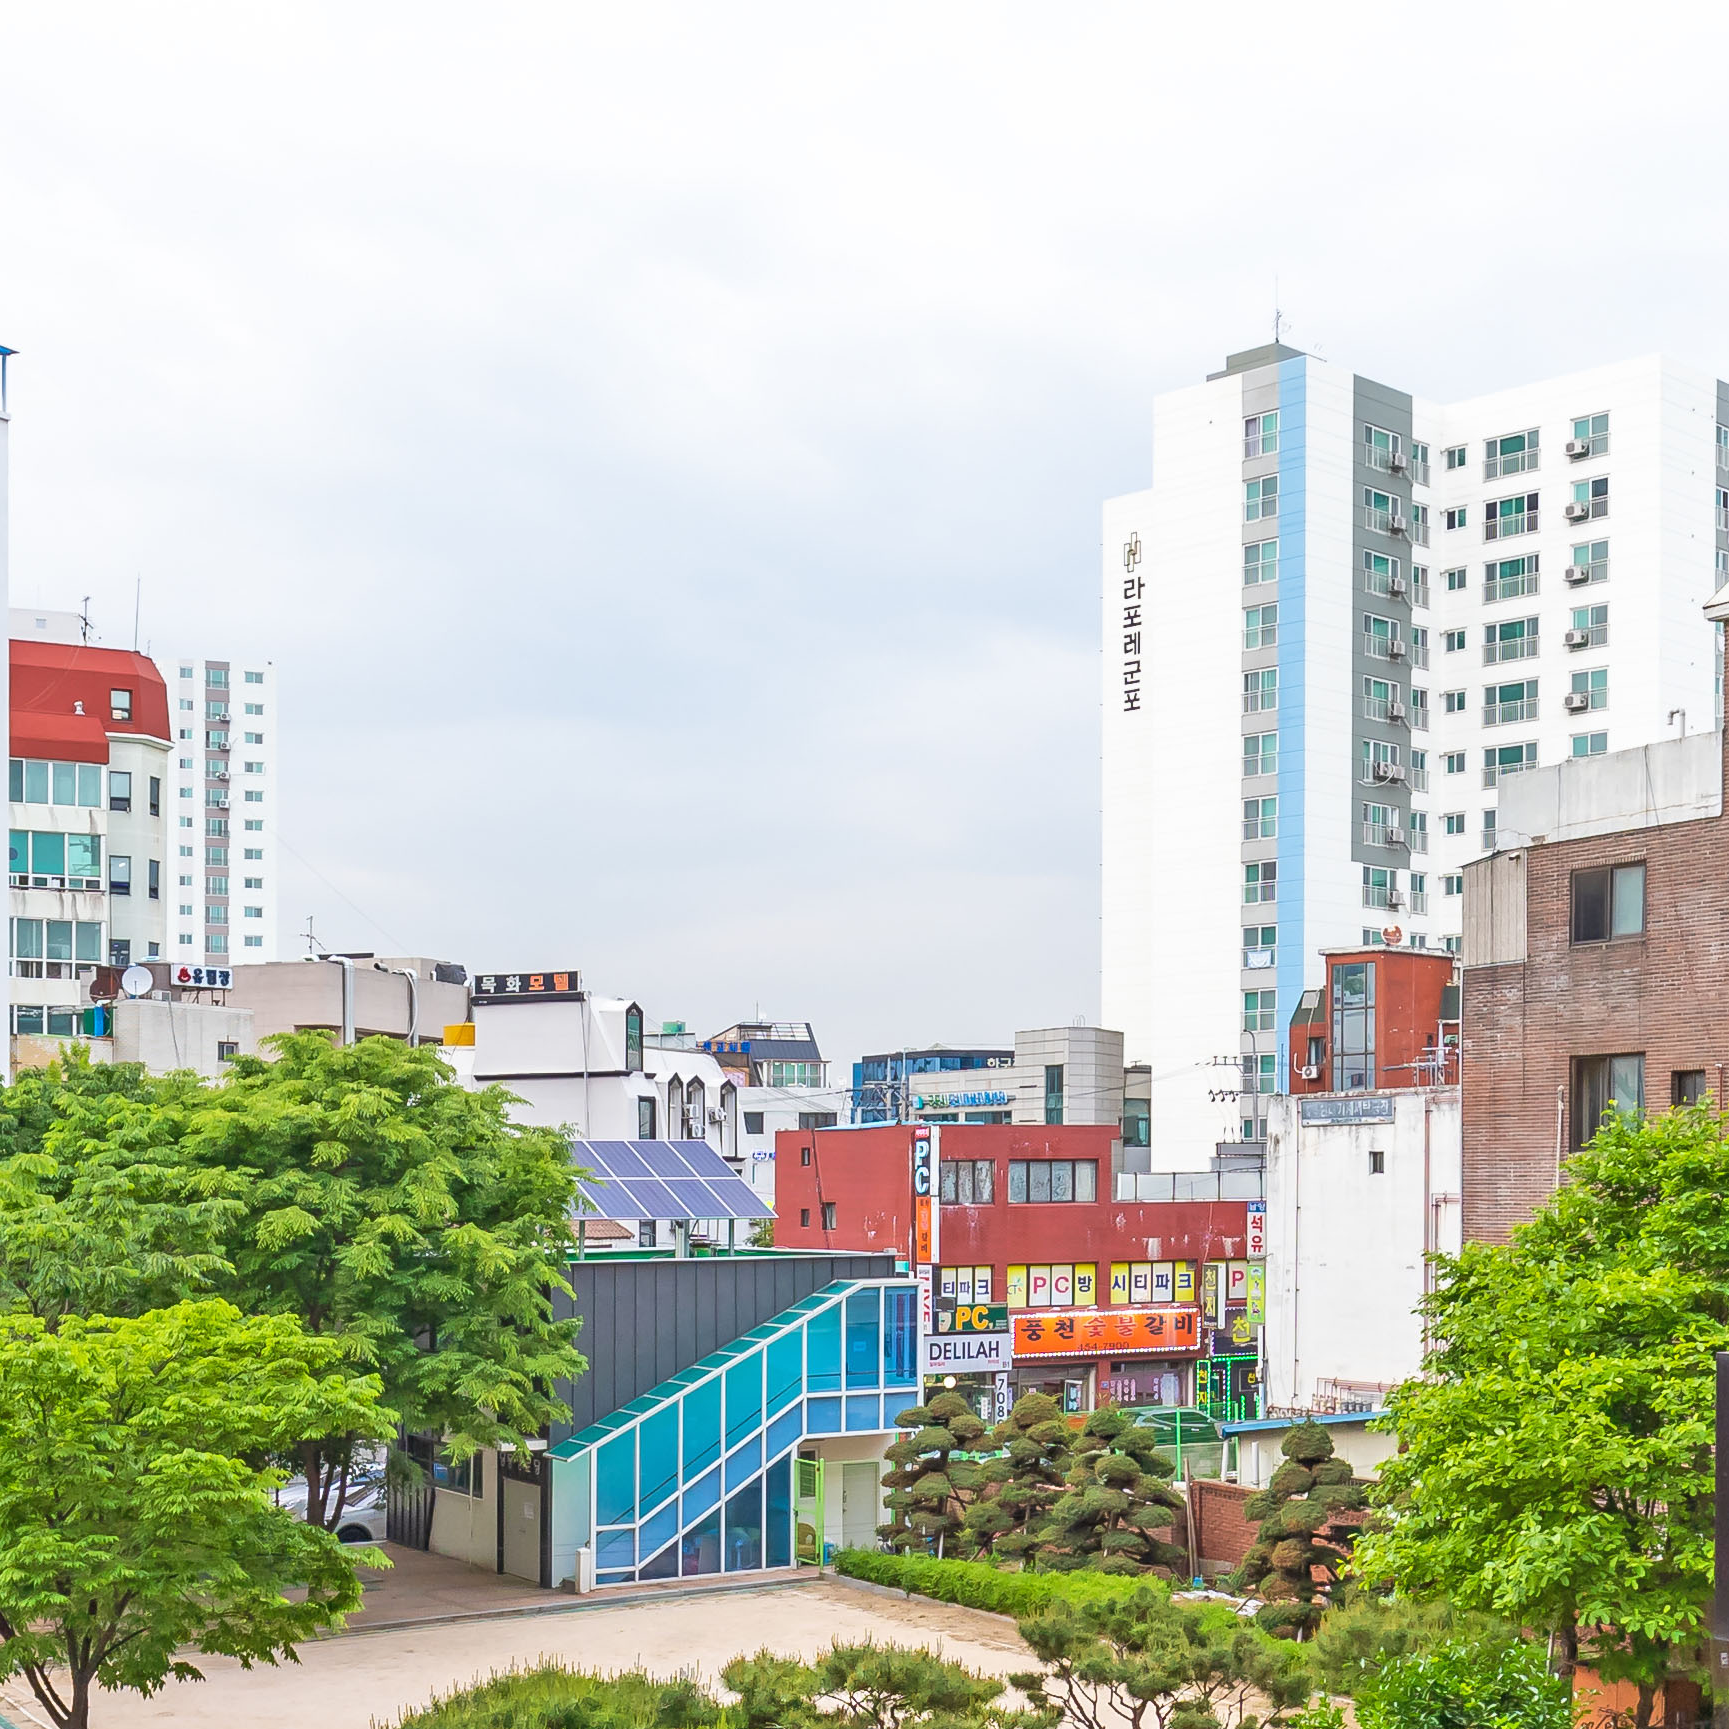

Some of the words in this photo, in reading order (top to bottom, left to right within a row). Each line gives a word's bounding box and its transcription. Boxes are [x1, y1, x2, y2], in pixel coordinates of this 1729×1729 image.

[1122, 575, 1145, 713] 라포레군포
[914, 1140, 930, 1194] PC
[1251, 1215, 1263, 1253] 석유
[1033, 1275, 1092, 1294] PC방
[1112, 1273, 1192, 1291] 시티파크
[1205, 1269, 1216, 1318] 천지
[929, 1341, 1000, 1361] DELILAH
